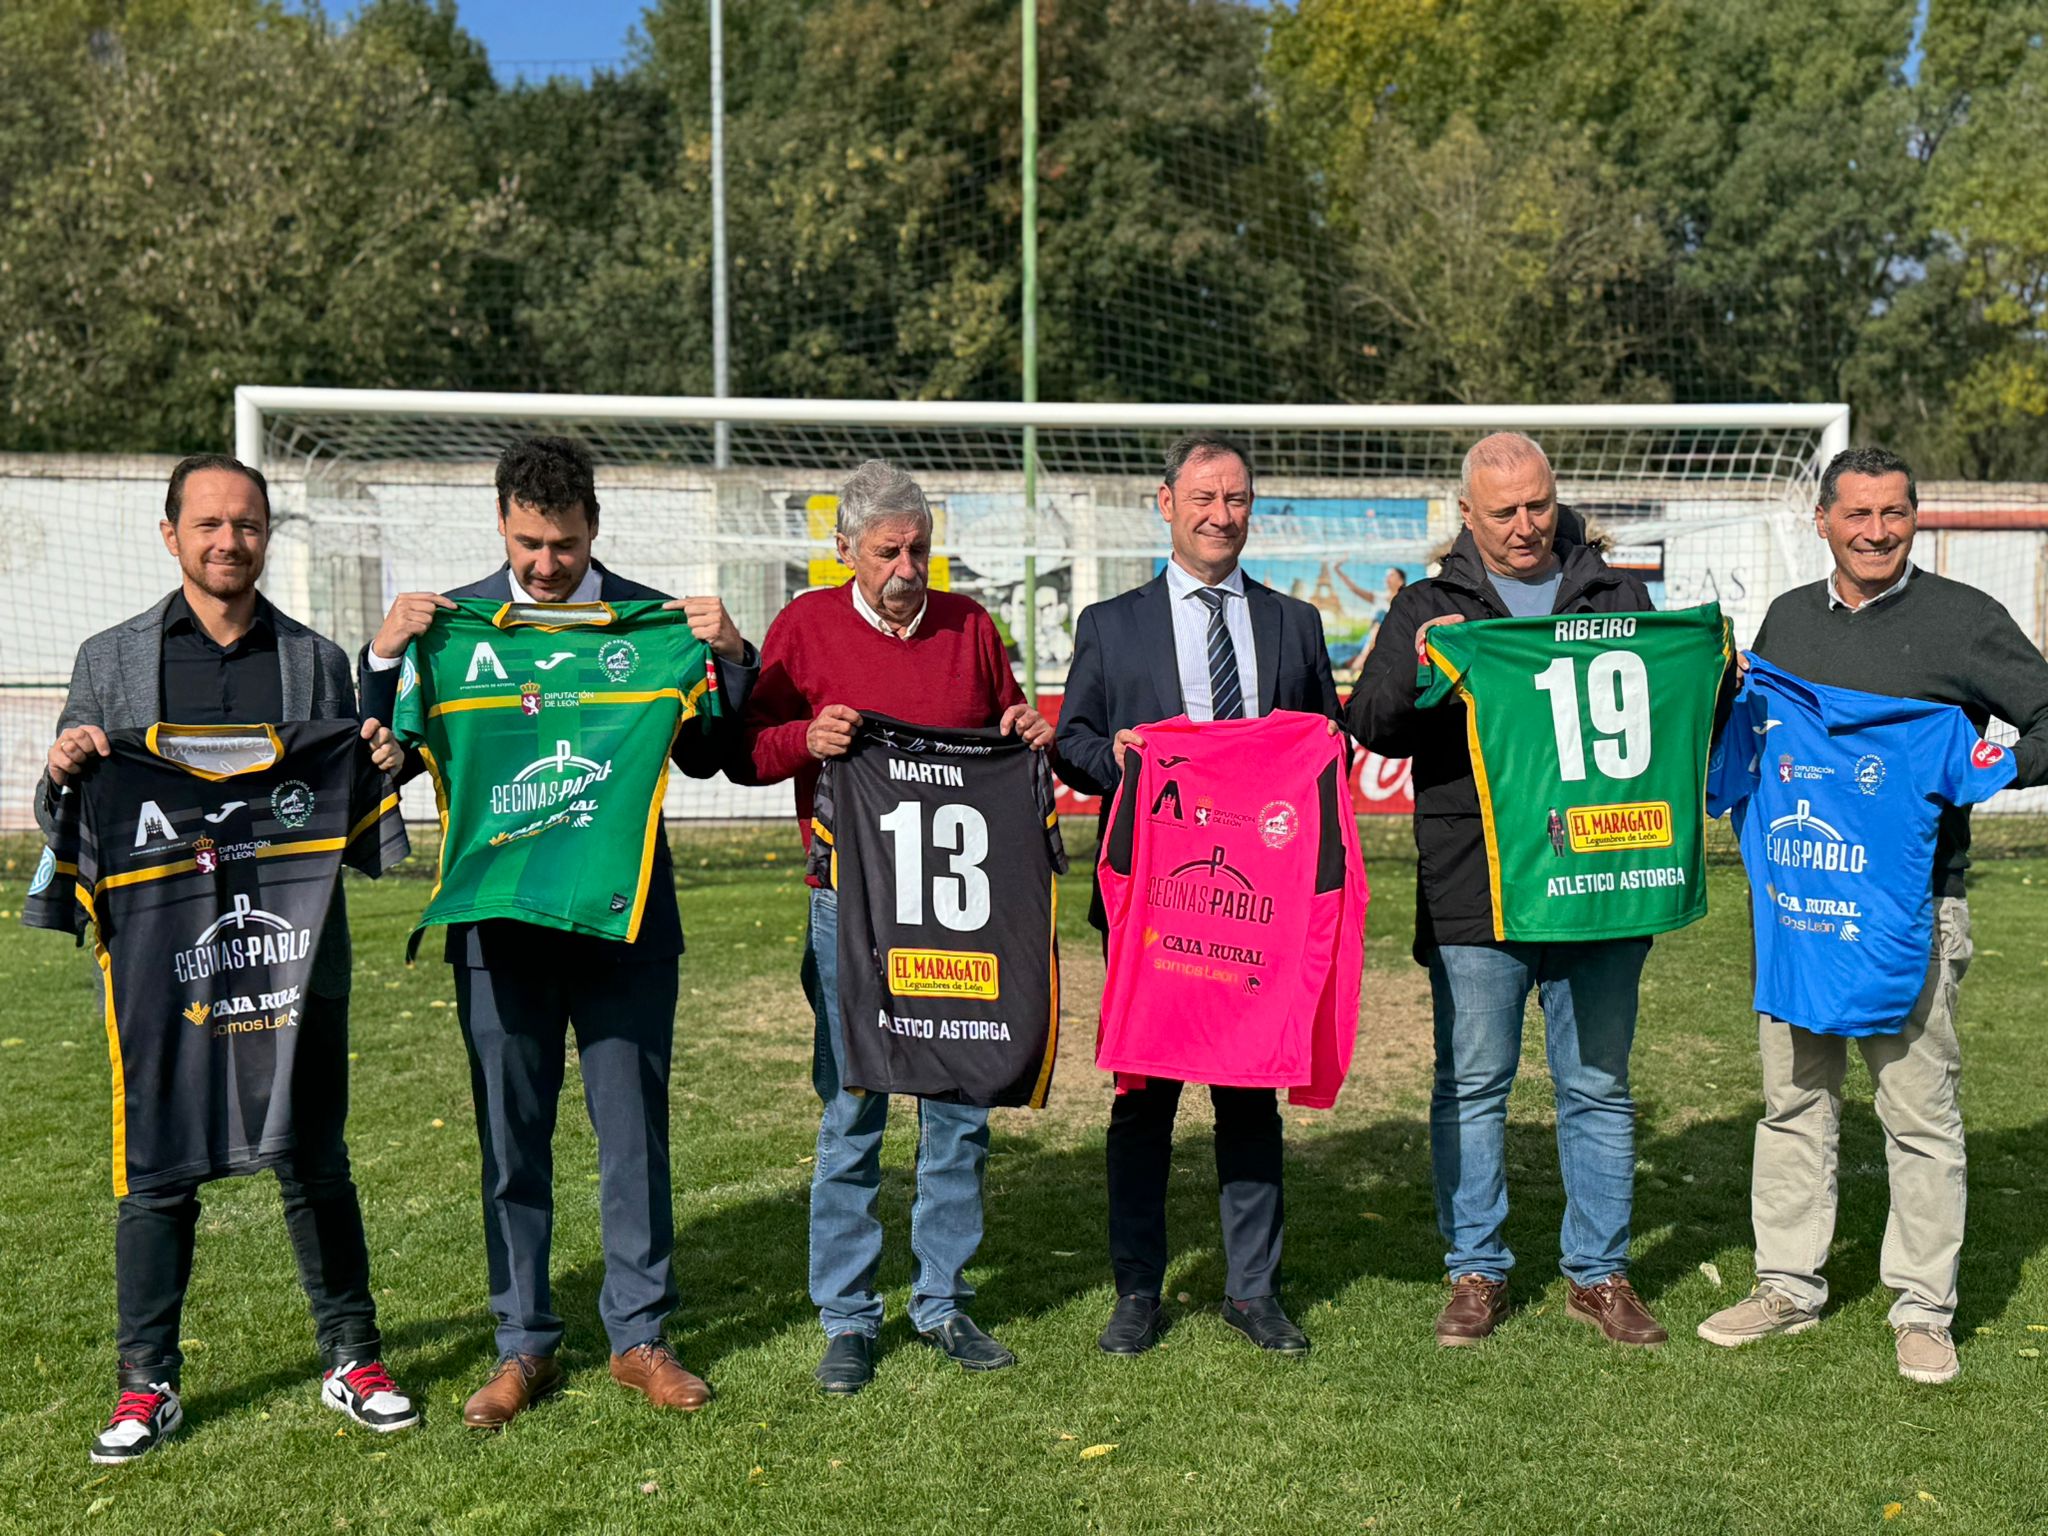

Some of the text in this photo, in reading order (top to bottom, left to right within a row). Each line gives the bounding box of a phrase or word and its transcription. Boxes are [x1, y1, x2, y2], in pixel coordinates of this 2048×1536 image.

[1555, 617, 1636, 642] RIBEIRO
[544, 691, 594, 700] DIPUTACIÓN
[545, 698, 580, 708] DE LEÓN
[1534, 650, 1651, 782] 19
[888, 758, 964, 787] MARTIN
[1573, 810, 1663, 836] EL MARAGATO
[218, 840, 272, 854] DIPUTACIÓN
[1586, 832, 1658, 846] Legumbres de León
[220, 848, 256, 862] DE LEÓN
[880, 800, 992, 932] 13
[1547, 867, 1685, 897] ATLETICO ASTORGA
[1805, 898, 1862, 917] RURAL
[1162, 935, 1266, 966] CAJA RURAL
[895, 957, 991, 982] EL MARAGATO
[905, 980, 983, 992] Legumbres de León
[213, 996, 256, 1018] CAJA
[939, 1020, 1011, 1041] ASTORGA
